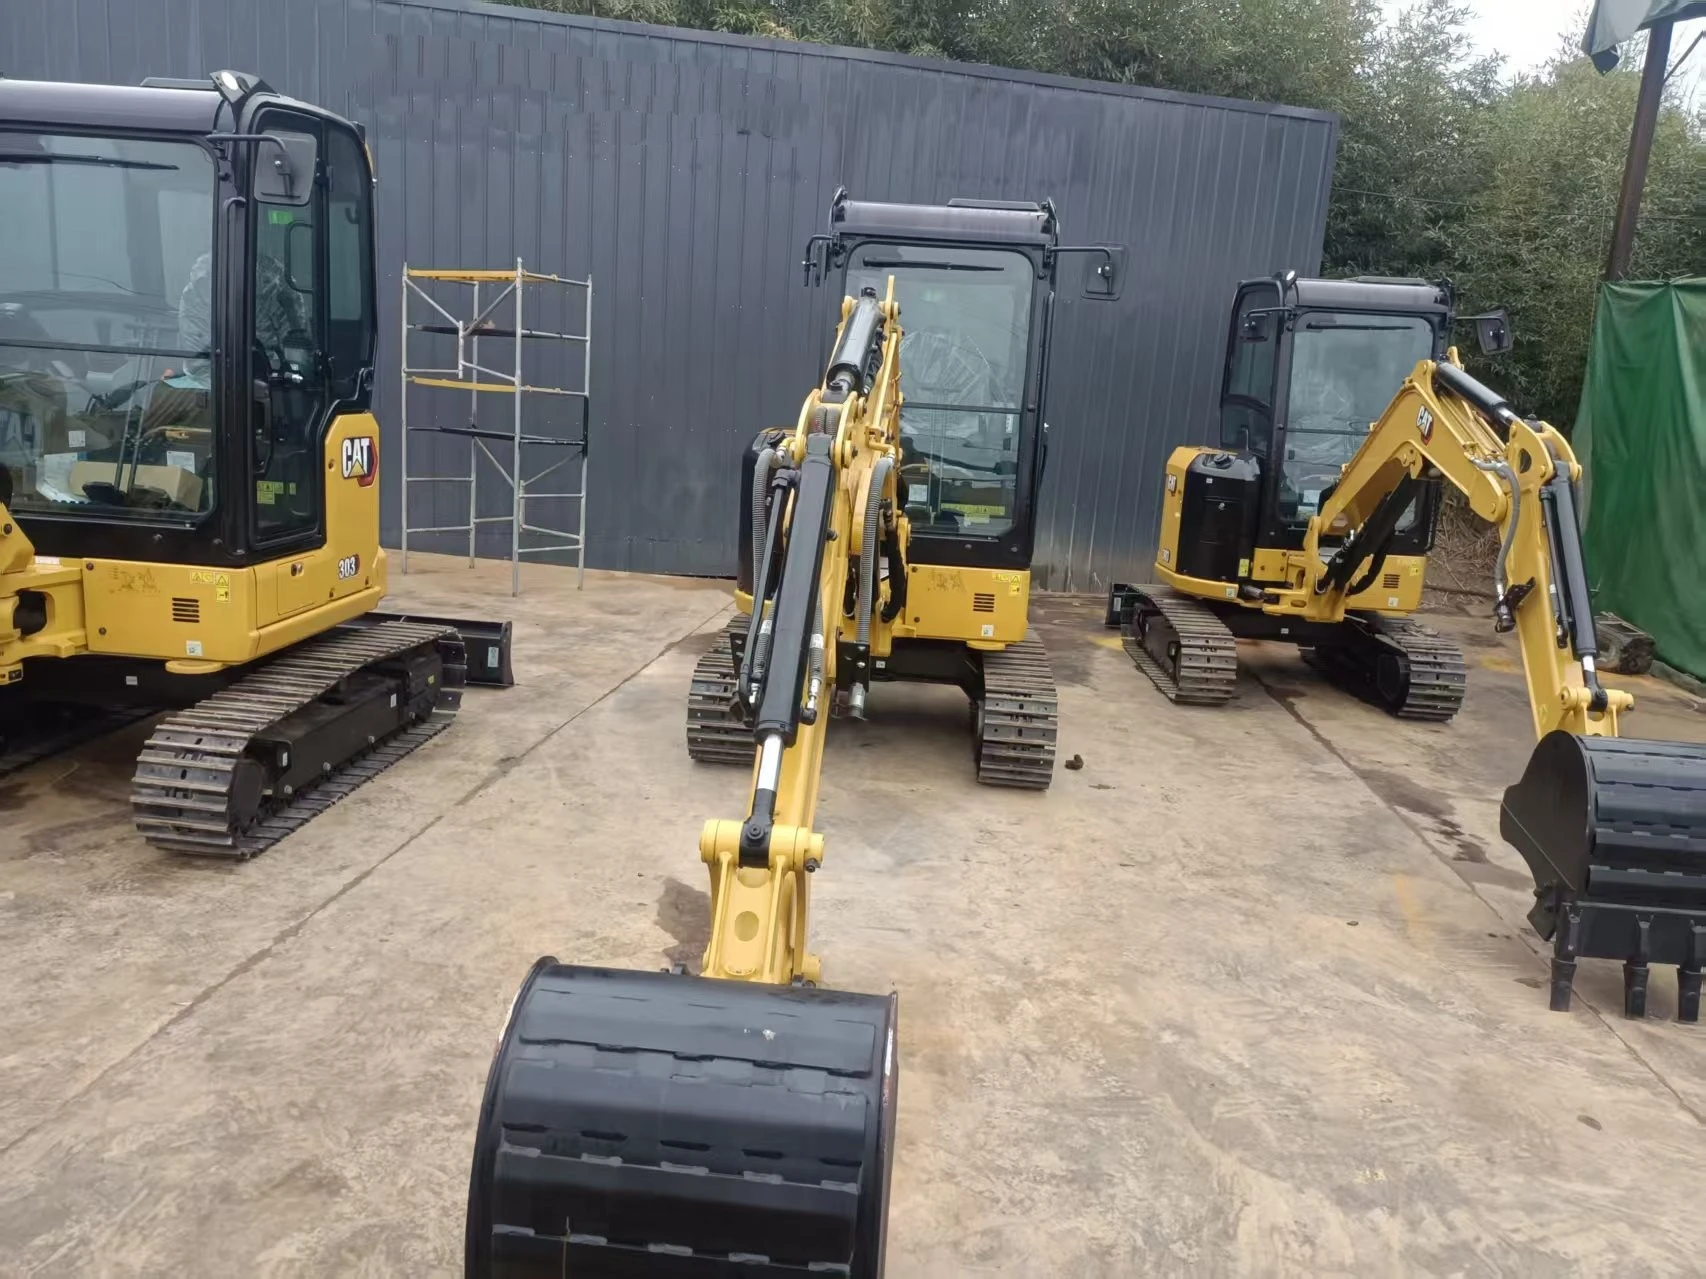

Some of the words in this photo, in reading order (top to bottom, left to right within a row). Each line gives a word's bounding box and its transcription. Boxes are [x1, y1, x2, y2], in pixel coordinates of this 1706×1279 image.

[1416, 405, 1433, 437] CAT
[342, 437, 370, 478] CAT
[338, 555, 356, 579] 303
